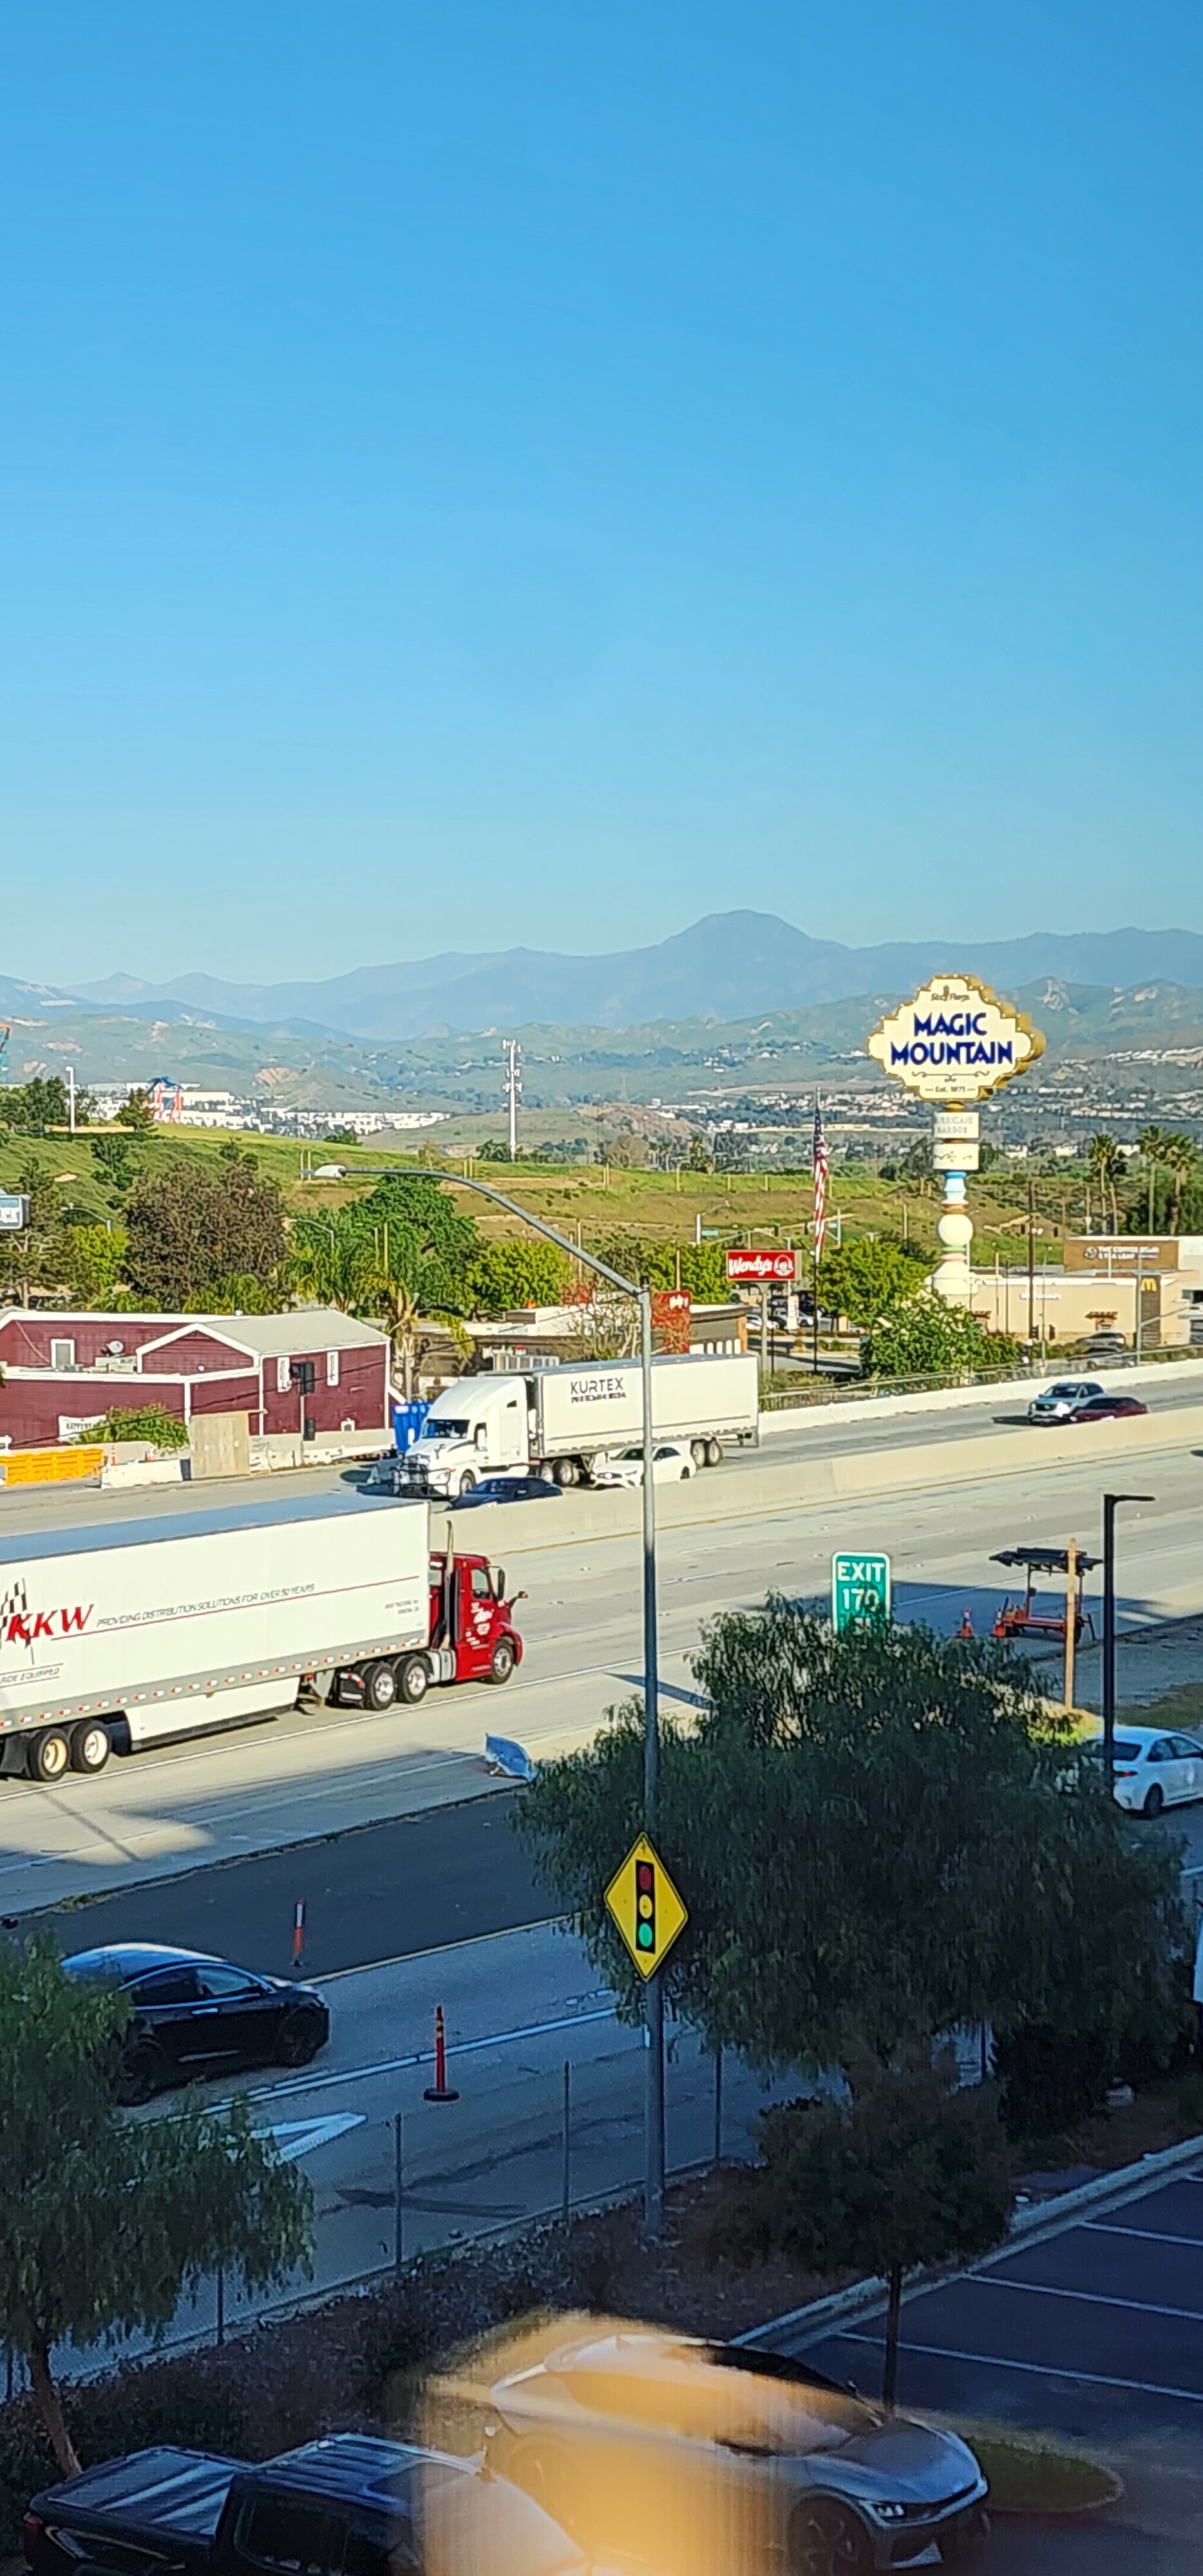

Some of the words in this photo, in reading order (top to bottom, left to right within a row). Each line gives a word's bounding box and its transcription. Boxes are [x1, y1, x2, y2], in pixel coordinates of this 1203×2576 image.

[913, 1012, 987, 1036] MAGIC
[890, 1041, 1013, 1066] MOUNTAIN
[729, 1255, 772, 1276] Wendy's
[571, 1377, 623, 1394] KURTEX
[837, 1562, 884, 1582] EXIT
[242, 1593, 258, 1603] FOR
[260, 1590, 280, 1600] OVER
[843, 1588, 879, 1611] 170
[5, 1604, 95, 1643] KKW
